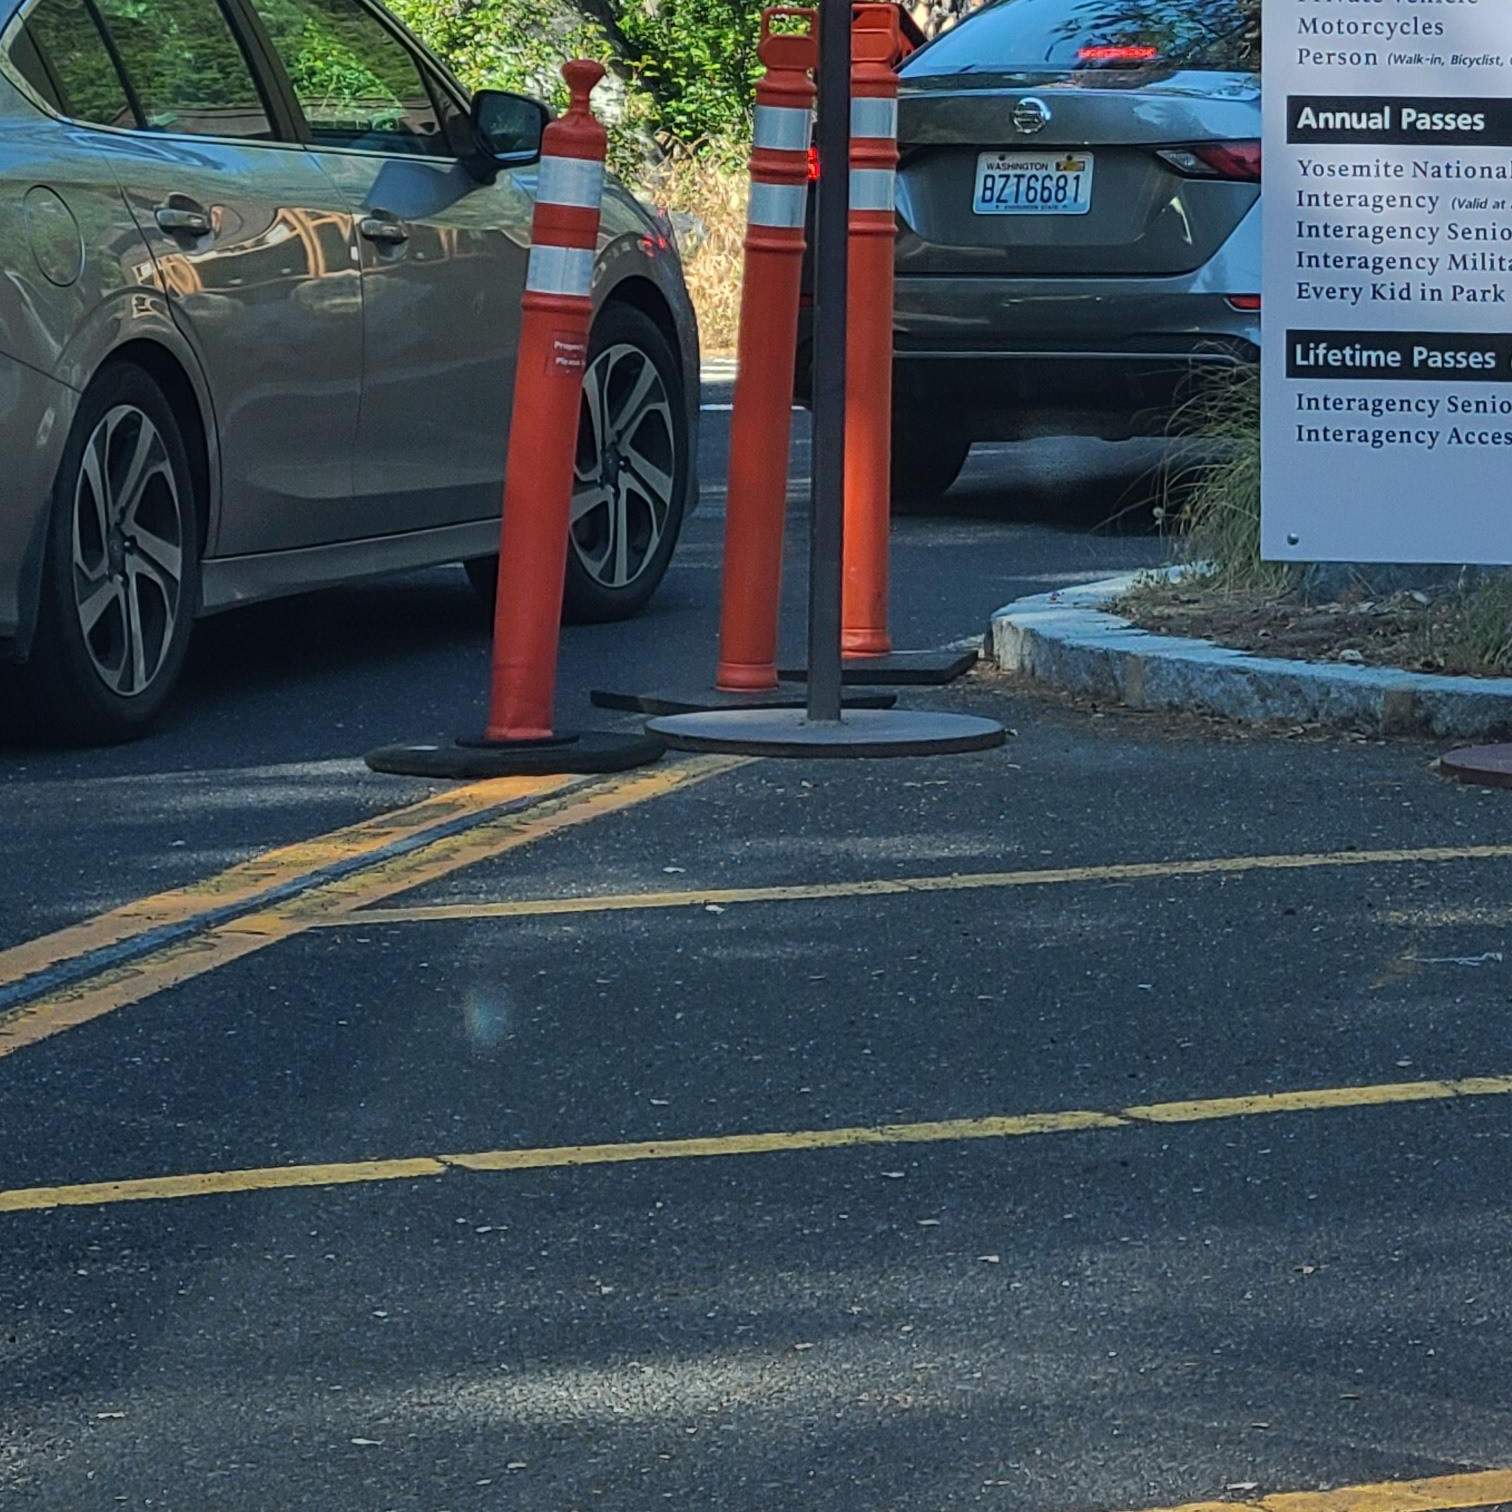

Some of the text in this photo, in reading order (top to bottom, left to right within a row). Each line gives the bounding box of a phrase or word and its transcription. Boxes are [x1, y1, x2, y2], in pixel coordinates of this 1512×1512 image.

[1297, 17, 1444, 39] Motorcycles
[1297, 48, 1377, 65] Person
[1387, 53, 1445, 67] (Walk-in,
[1450, 54, 1504, 68] Bicyclist,
[1297, 106, 1485, 131] Annual Passes
[986, 161, 1049, 171] WASHINGTON
[1298, 159, 1404, 178] Yosemite
[981, 174, 1081, 204] BZT6681
[1296, 190, 1439, 214] Interagency
[1451, 197, 1487, 211] (Valid
[1492, 198, 1505, 210] at
[1296, 221, 1439, 245] Interagency
[1296, 251, 1439, 275] Interagency
[1296, 282, 1363, 305] Every
[1371, 283, 1411, 301] Kid
[1420, 283, 1443, 301] in
[1451, 285, 1505, 302] Park
[1295, 344, 1401, 367] Lifetime
[1413, 346, 1495, 369] Passes
[1296, 393, 1440, 418] Interagency
[1296, 425, 1440, 450] Interagency
